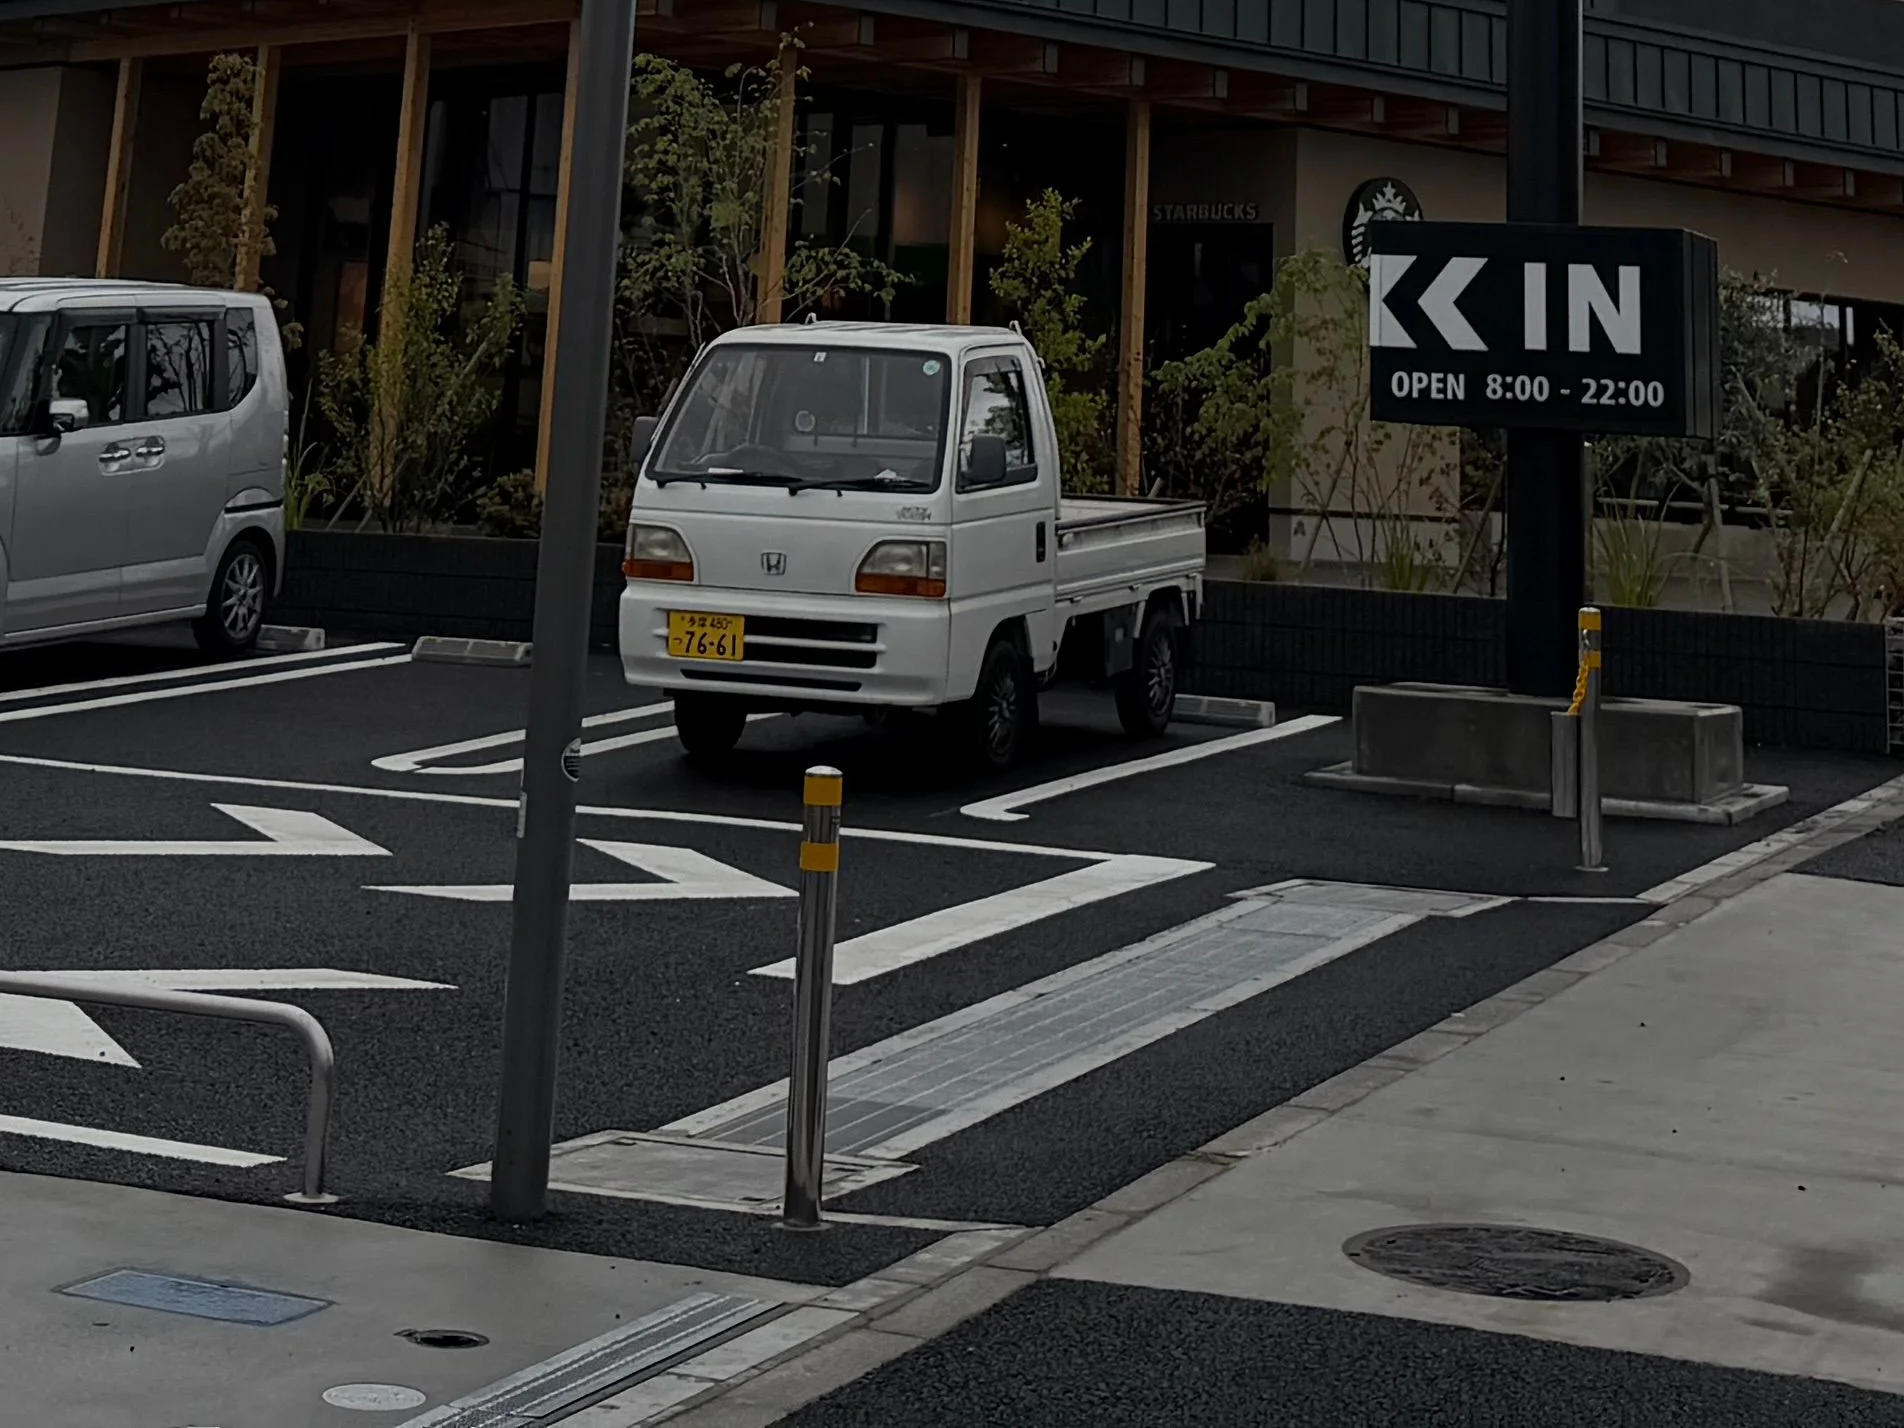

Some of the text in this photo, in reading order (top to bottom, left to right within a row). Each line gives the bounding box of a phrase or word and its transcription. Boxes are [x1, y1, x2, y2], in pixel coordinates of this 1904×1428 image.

[1524, 262, 1642, 355] IN
[1391, 371, 1466, 401] OPEN
[1485, 374, 1550, 402] 8:00
[1580, 377, 1665, 408] 22:00
[685, 631, 736, 657] 76-61
